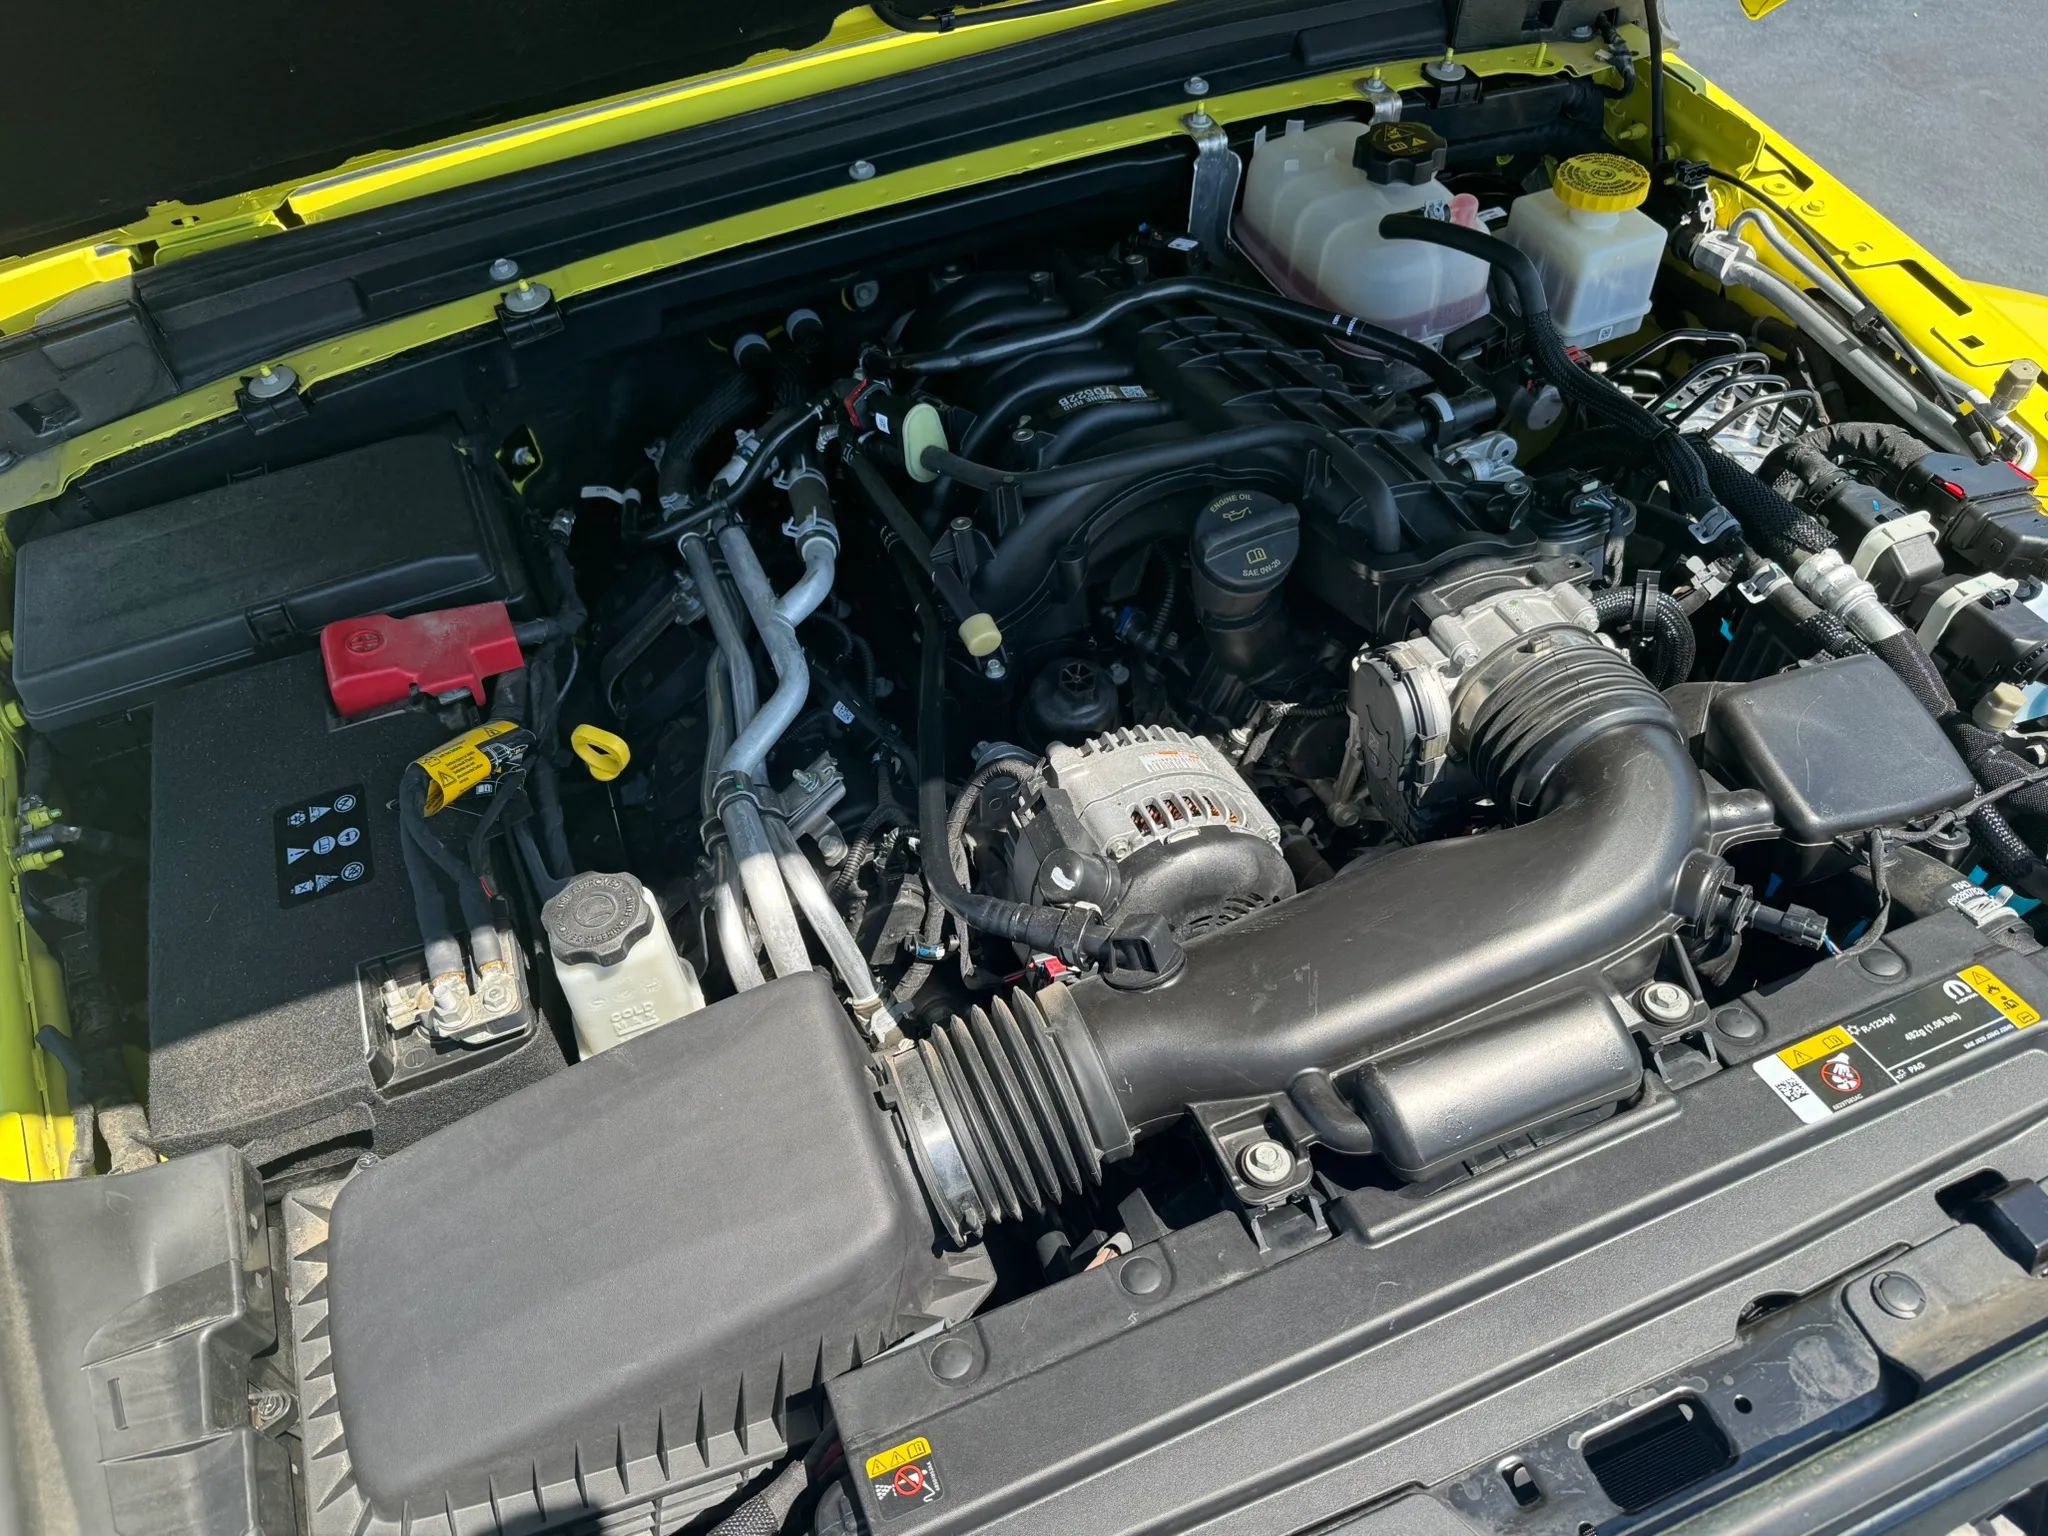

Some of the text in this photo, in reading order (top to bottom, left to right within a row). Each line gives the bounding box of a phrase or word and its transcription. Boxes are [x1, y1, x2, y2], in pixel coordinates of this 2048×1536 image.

[1209, 493, 1252, 513] ENGINE OIL
[1242, 568, 1259, 577] SAE
[1951, 880, 1972, 891] RAD
[610, 1001, 654, 1023] COLD
[1907, 1061, 1926, 1075] PAG
